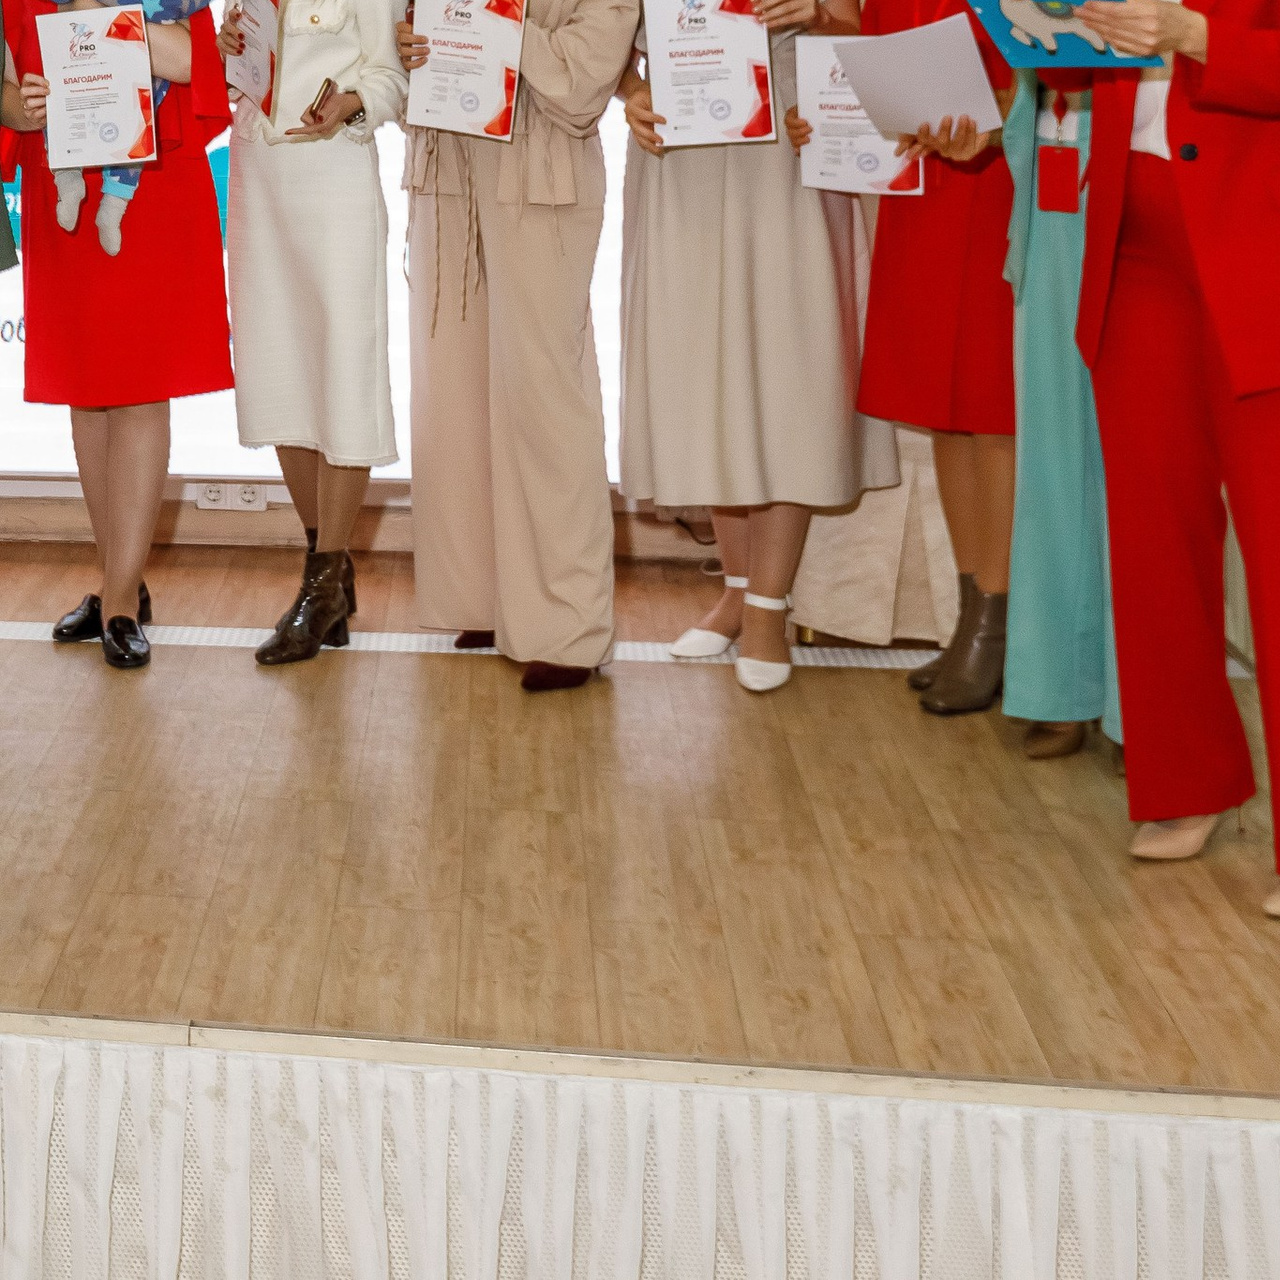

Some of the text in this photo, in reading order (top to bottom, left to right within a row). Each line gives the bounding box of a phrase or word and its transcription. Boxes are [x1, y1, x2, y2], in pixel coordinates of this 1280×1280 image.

[454, 11, 472, 19] PRO
[79, 44, 96, 52] PRO
[432, 39, 483, 52] БЛАГОДАРИМ
[63, 73, 113, 85] БЛАГОДАРИМ
